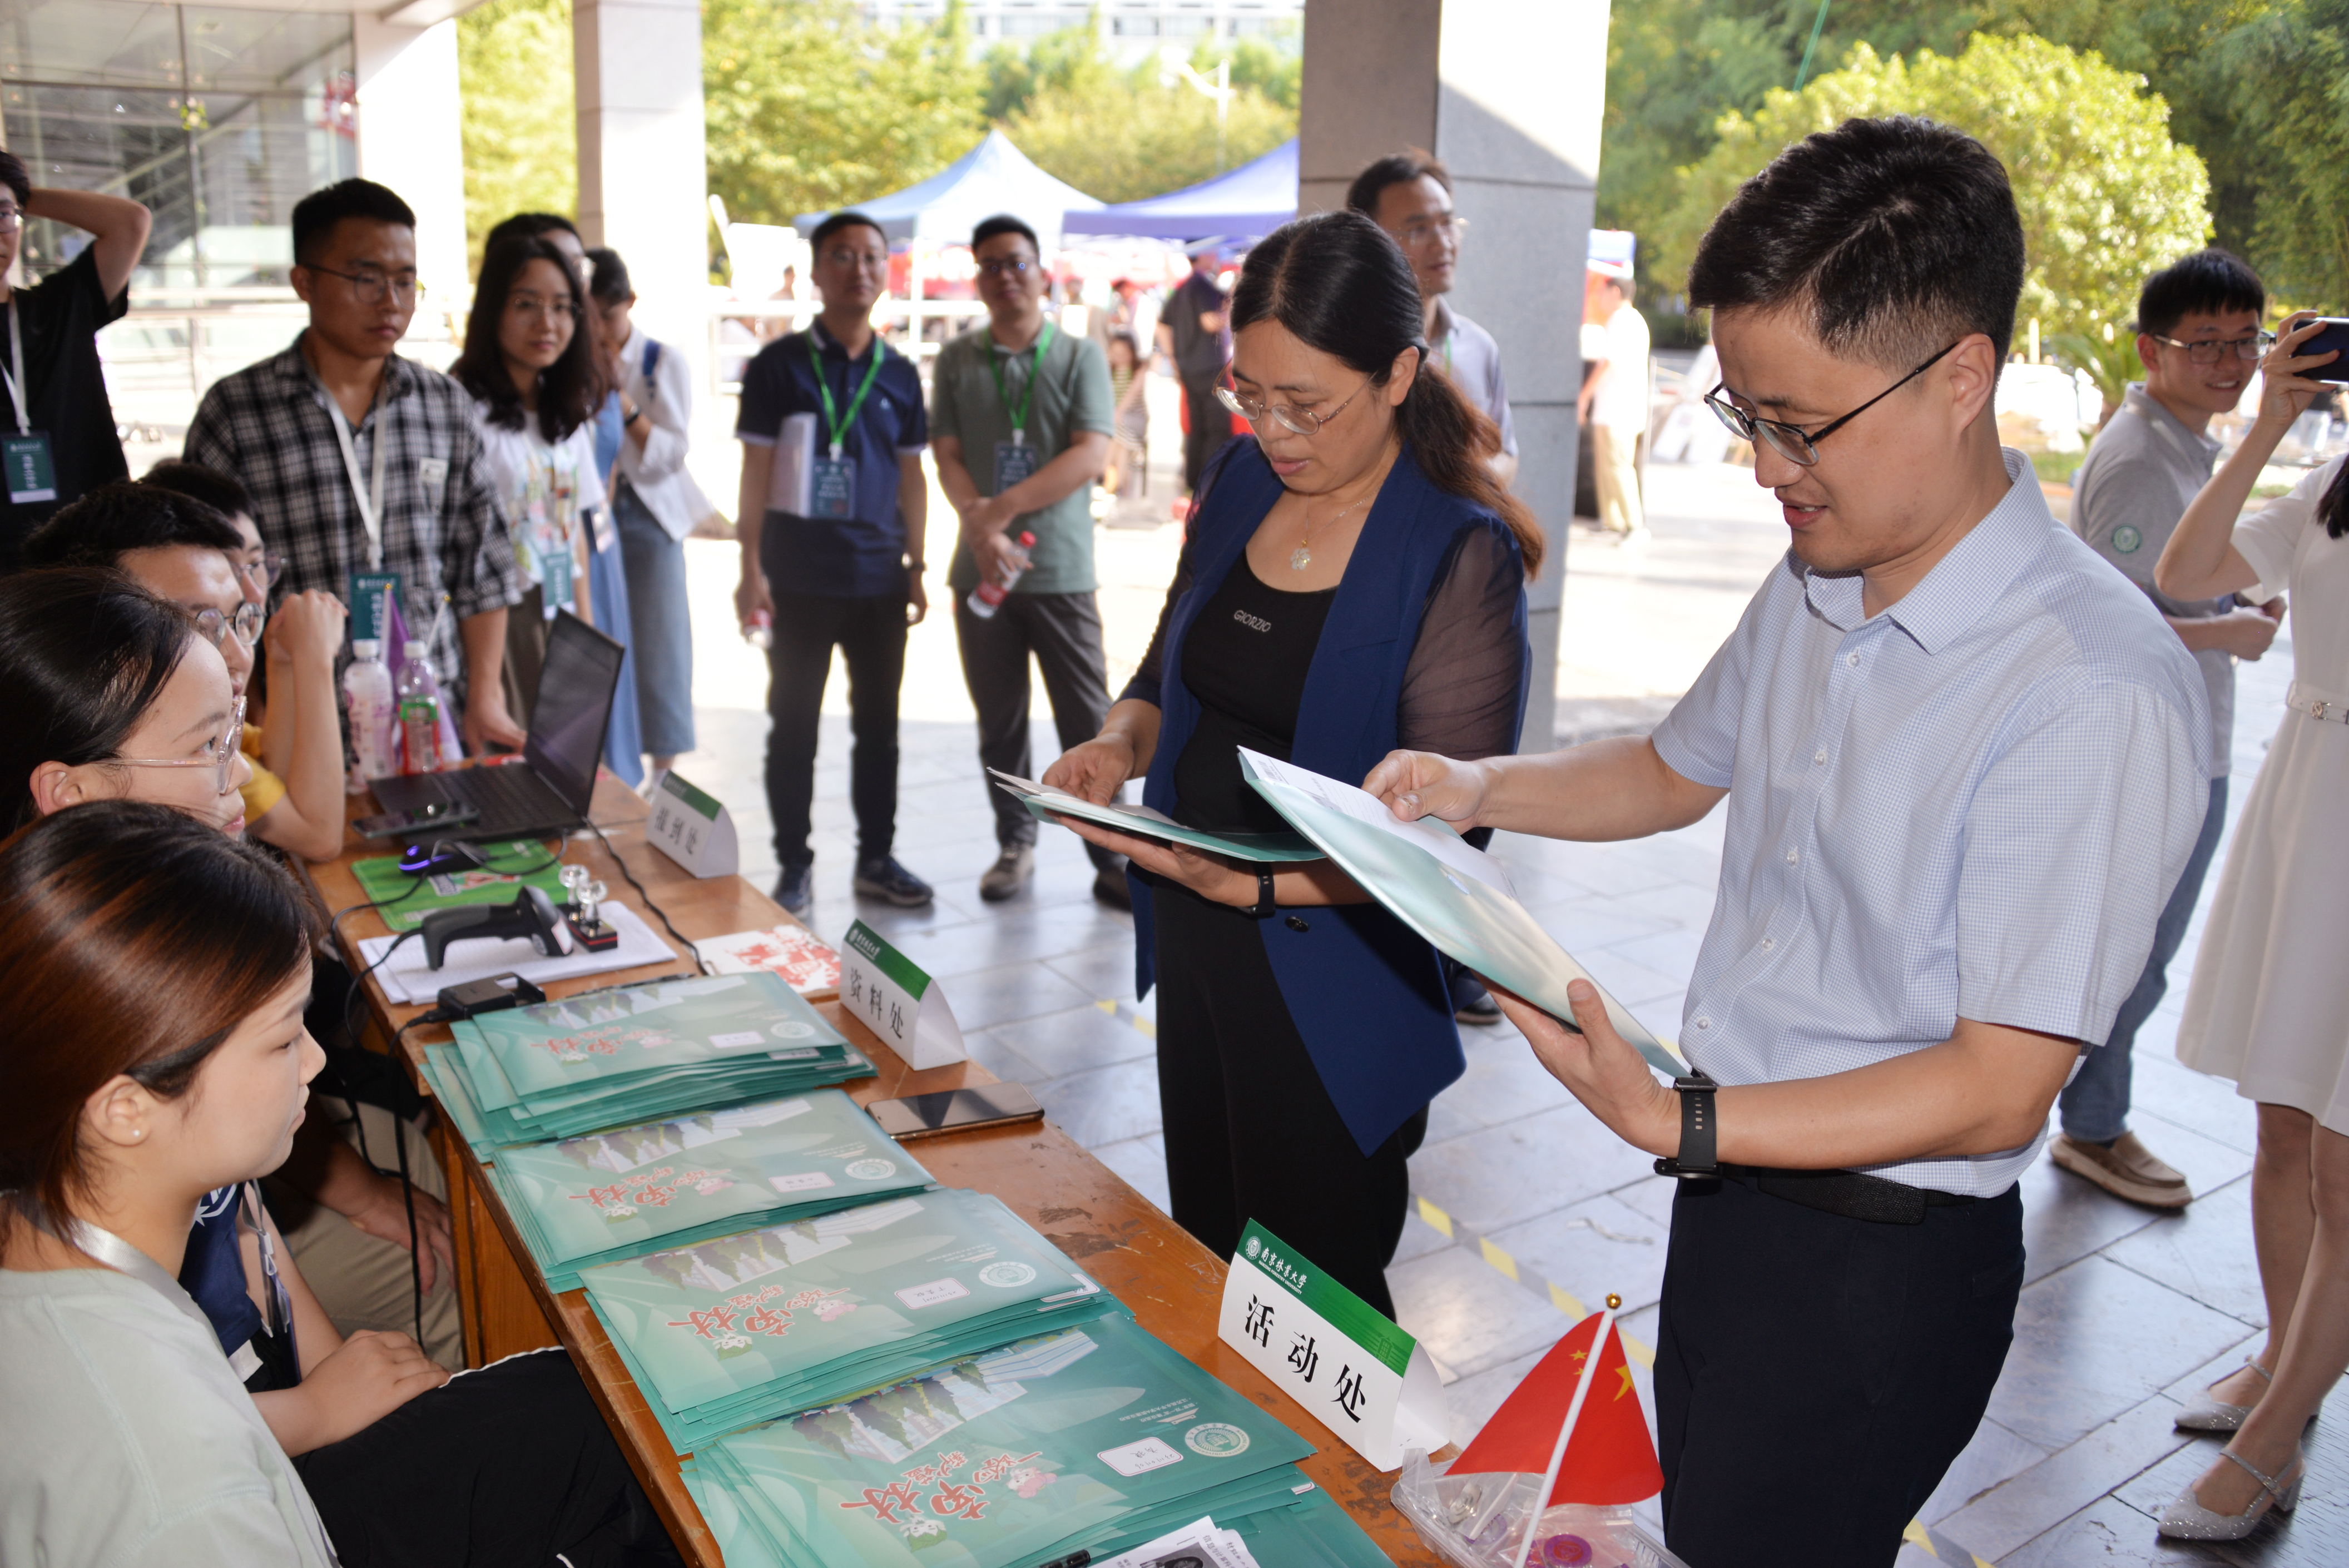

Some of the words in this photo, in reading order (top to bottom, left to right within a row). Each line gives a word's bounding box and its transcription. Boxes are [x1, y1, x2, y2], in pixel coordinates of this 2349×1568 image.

[1233, 609, 1271, 633] GIORZIO
[850, 967, 903, 1039] 资料处
[1258, 1260, 1271, 1272] NANJING
[1271, 1269, 1285, 1282] FORESTRY
[1285, 1279, 1302, 1294] UNIVERSITY
[1245, 1294, 1366, 1423] 活动处
[1190, 1445, 1223, 1456] UNIVERSITY
[1224, 1443, 1246, 1456] FORESTRY
